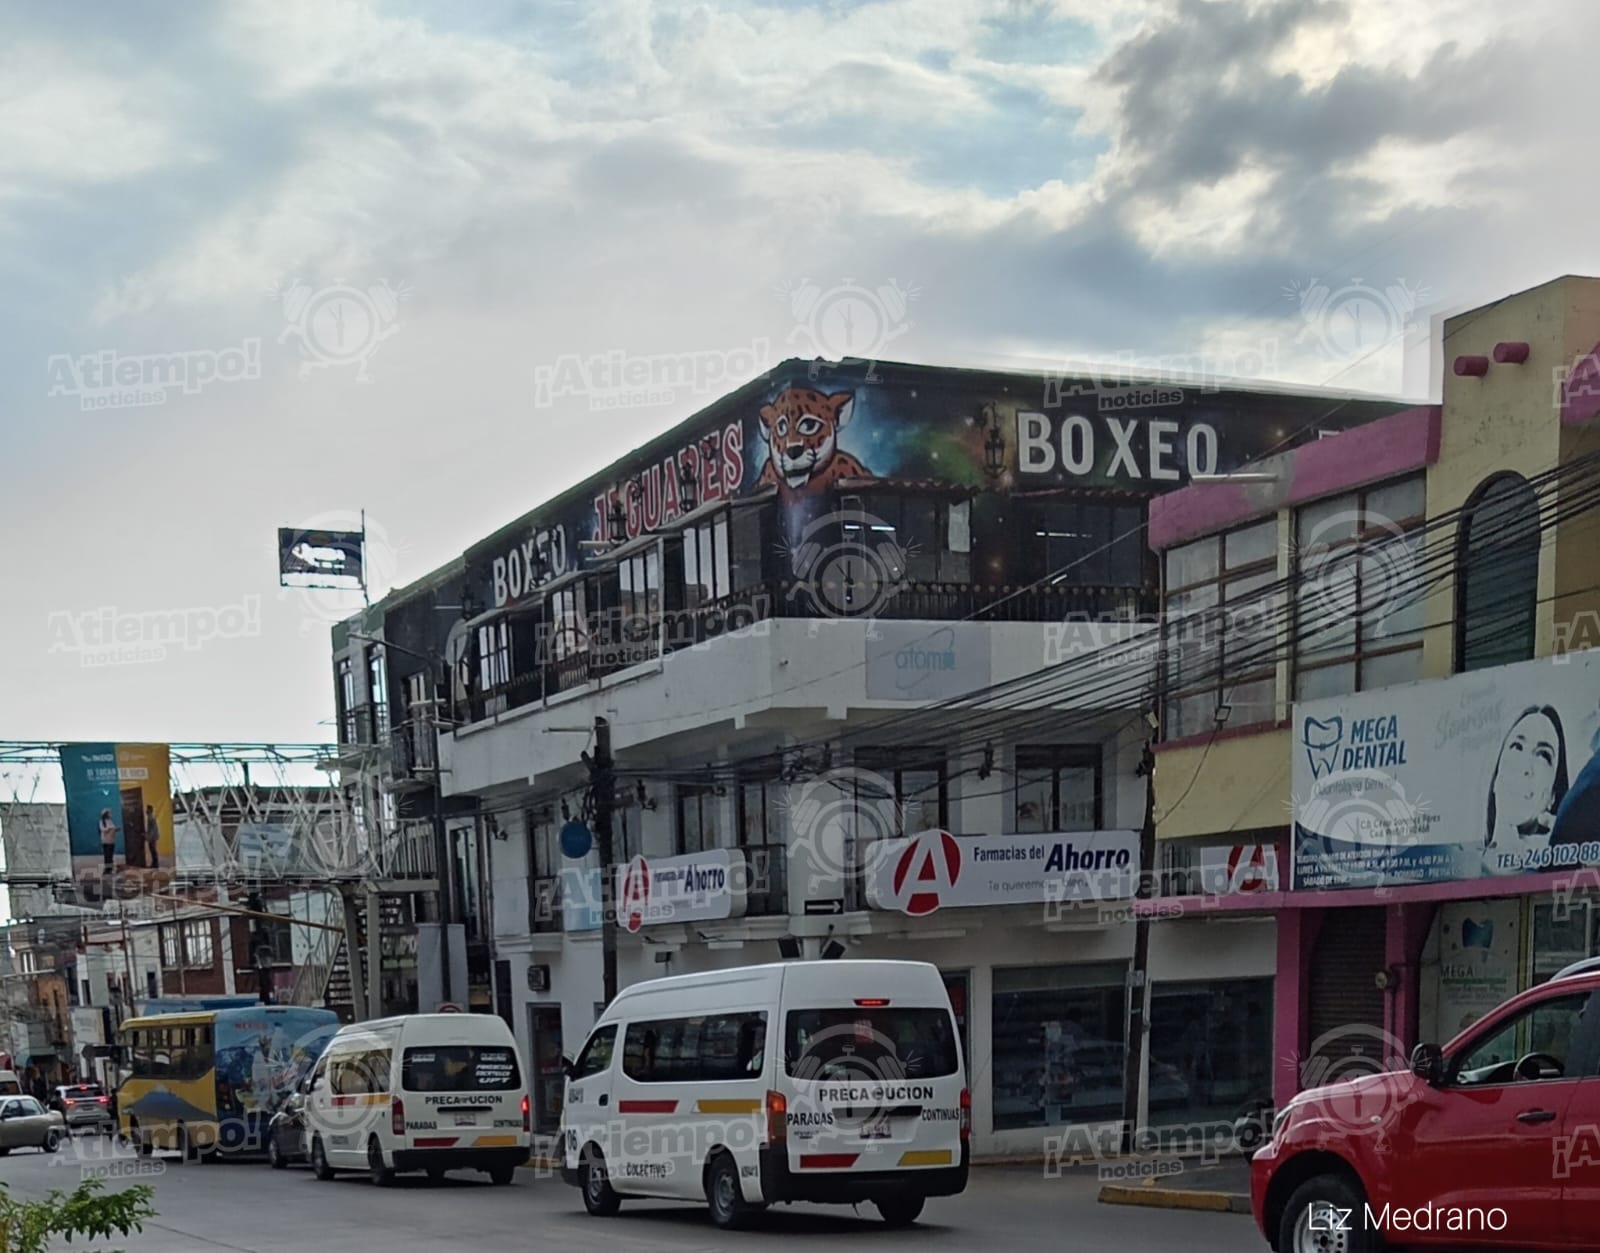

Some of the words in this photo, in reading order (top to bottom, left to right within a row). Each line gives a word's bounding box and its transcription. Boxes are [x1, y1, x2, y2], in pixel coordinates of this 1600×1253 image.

[1018, 412, 1218, 481] BOXEO
[1351, 715, 1397, 744] MEGA
[1342, 741, 1407, 770] DENTAL
[974, 845, 1027, 862] Farmacias
[1029, 845, 1045, 860] del
[1044, 843, 1130, 873] Ahorro
[1525, 847, 1550, 866] 246
[1555, 845, 1577, 864] 102
[684, 864, 725, 893] Ahorro
[406, 1121, 437, 1130] PARADAS
[787, 1112, 833, 1126] PARADAS
[922, 1108, 960, 1122] CONTINUAS
